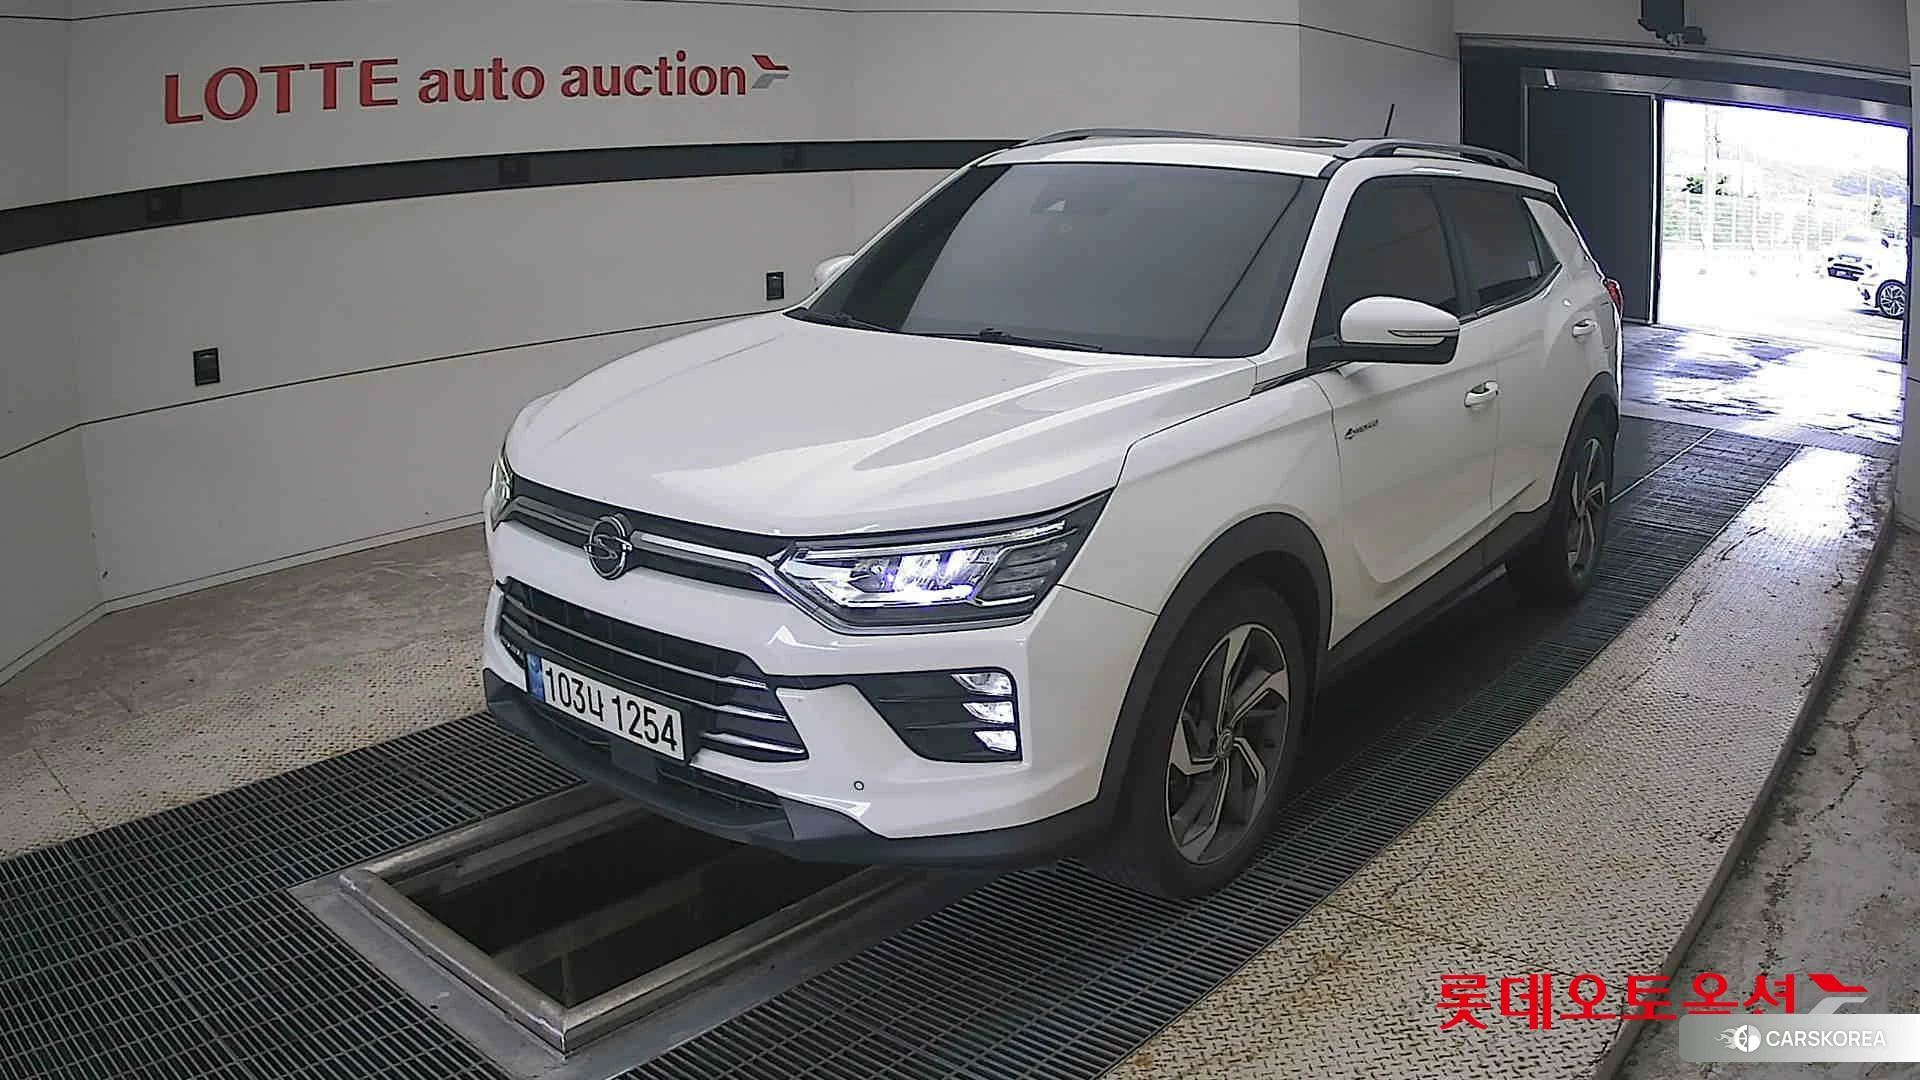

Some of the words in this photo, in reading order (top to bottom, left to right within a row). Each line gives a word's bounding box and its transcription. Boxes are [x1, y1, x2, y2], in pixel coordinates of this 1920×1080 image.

[164, 58, 399, 125] LOTTE
[418, 57, 546, 104] auto
[561, 50, 748, 98] auction
[545, 667, 604, 722] 103나
[611, 695, 678, 752] 1254
